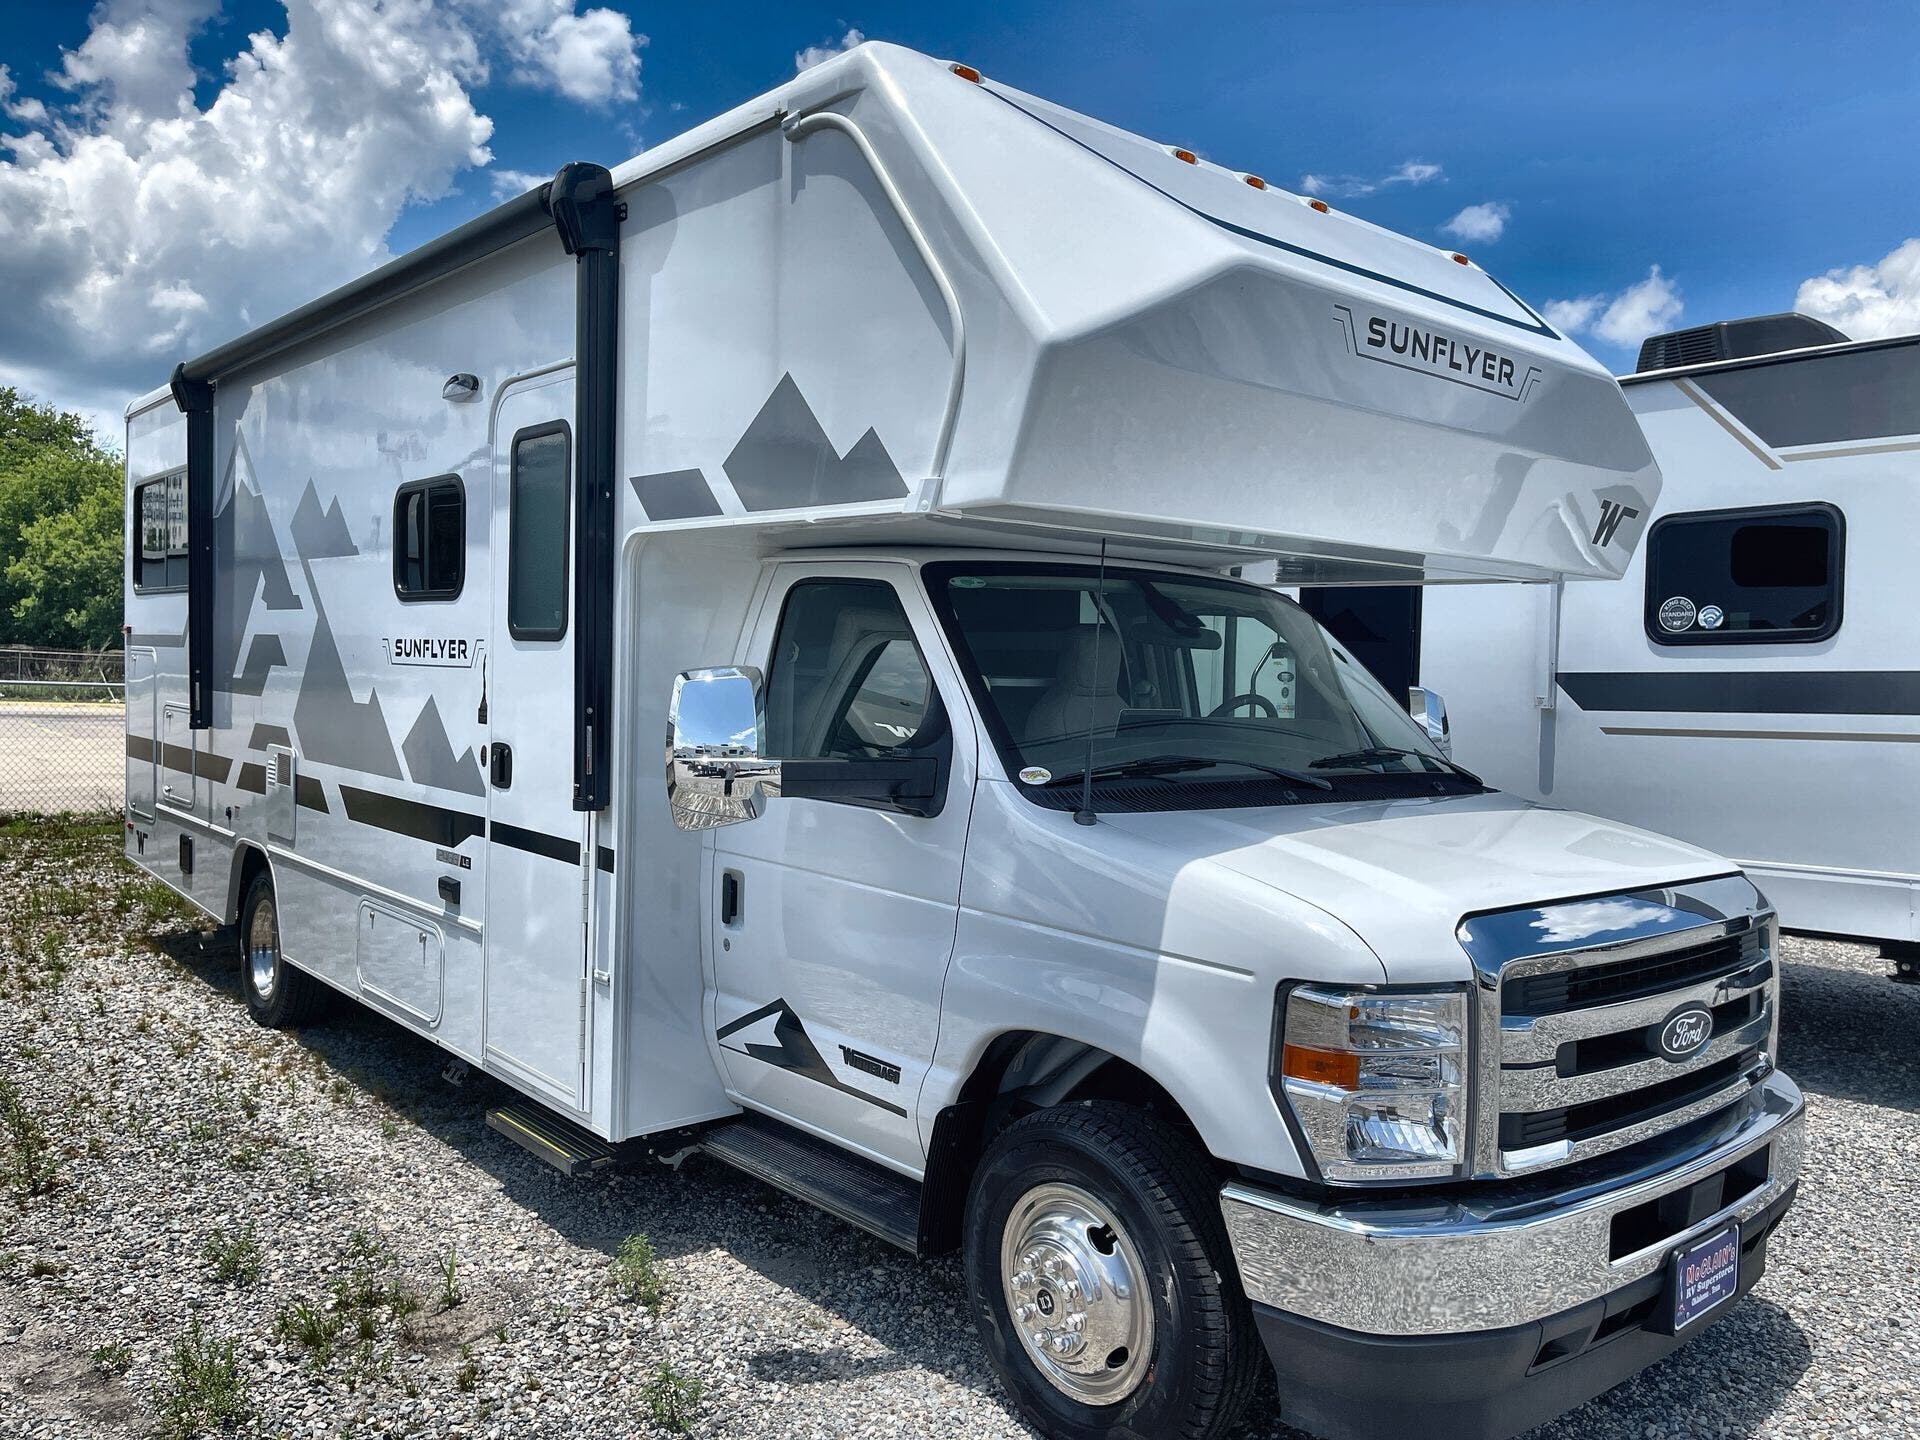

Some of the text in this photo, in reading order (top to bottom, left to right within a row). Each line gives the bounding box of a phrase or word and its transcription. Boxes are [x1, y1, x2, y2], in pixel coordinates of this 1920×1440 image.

[1367, 316, 1514, 387] SUNFLYER
[1592, 499, 1639, 547] W
[1664, 600, 1678, 610] KING
[395, 638, 468, 659] SUNFLYER
[1672, 1016, 1704, 1049] Ford
[1686, 1264, 1734, 1300] RV Superstores
